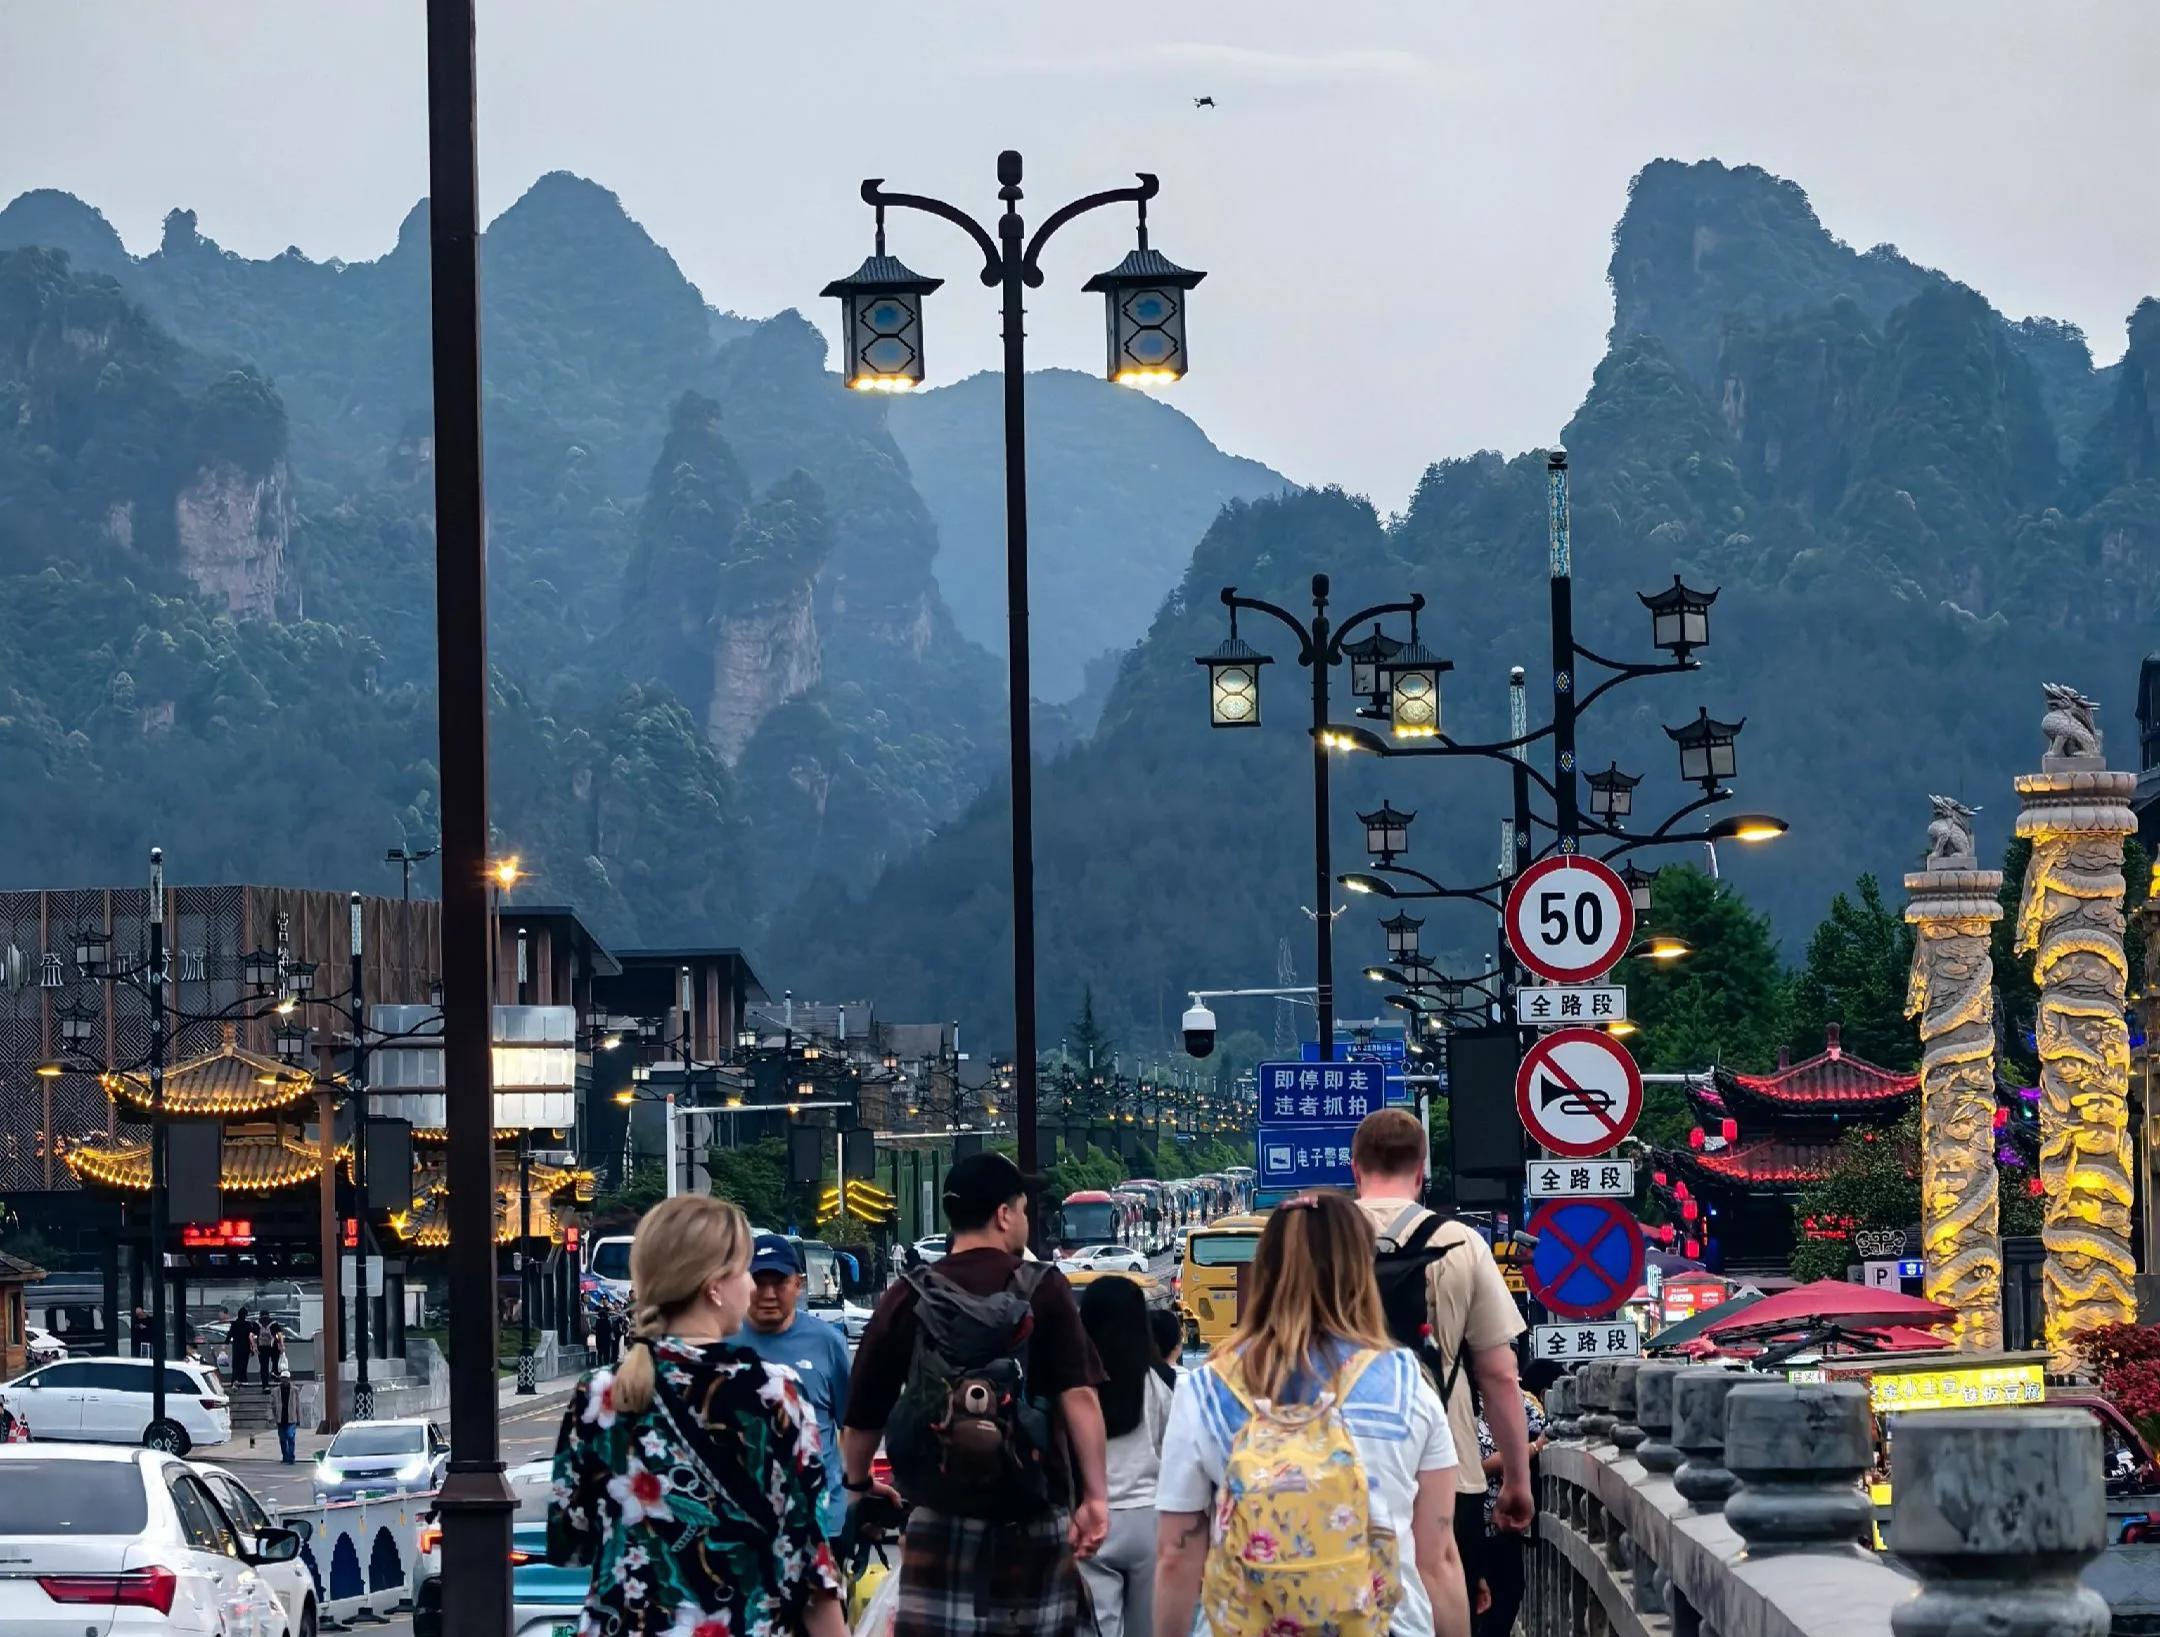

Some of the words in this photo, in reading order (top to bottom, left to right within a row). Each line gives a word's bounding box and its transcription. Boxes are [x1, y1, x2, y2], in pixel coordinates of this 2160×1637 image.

[1540, 891, 1603, 946] 50
[1530, 993, 1613, 1018] 全路段
[1274, 1069, 1369, 1091] 即停即走
[1274, 1094, 1369, 1117] 违者抓拍
[1296, 1146, 1352, 1169] 电子警察
[1540, 1166, 1622, 1192] 全路段
[1875, 1267, 1889, 1285] P
[1546, 1328, 1629, 1356] 全路段
